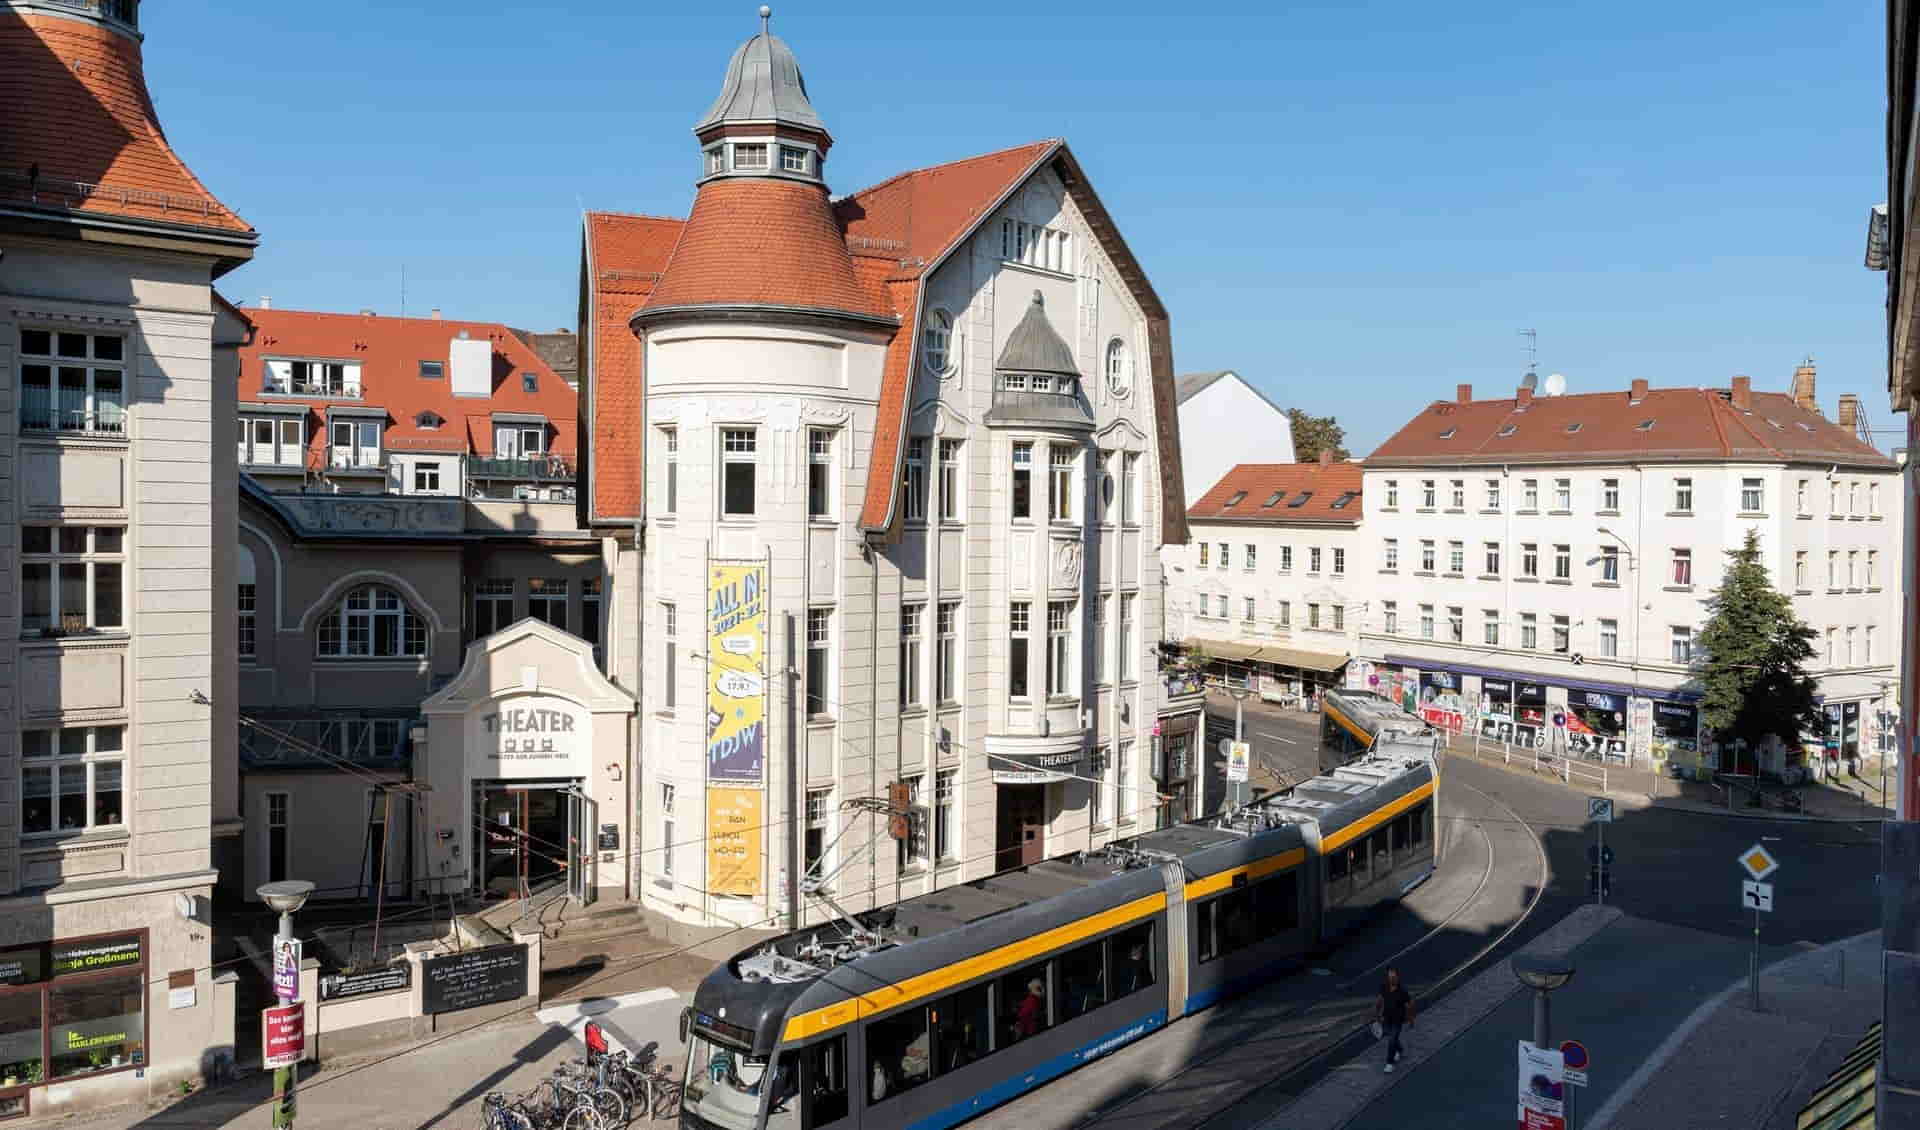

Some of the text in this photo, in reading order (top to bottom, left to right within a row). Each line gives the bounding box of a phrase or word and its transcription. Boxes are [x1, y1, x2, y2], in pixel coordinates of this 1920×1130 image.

[712, 568, 761, 621] ALL IN
[481, 709, 575, 734] THEATER
[710, 721, 757, 766] TDJW
[86, 951, 139, 967] Großmann
